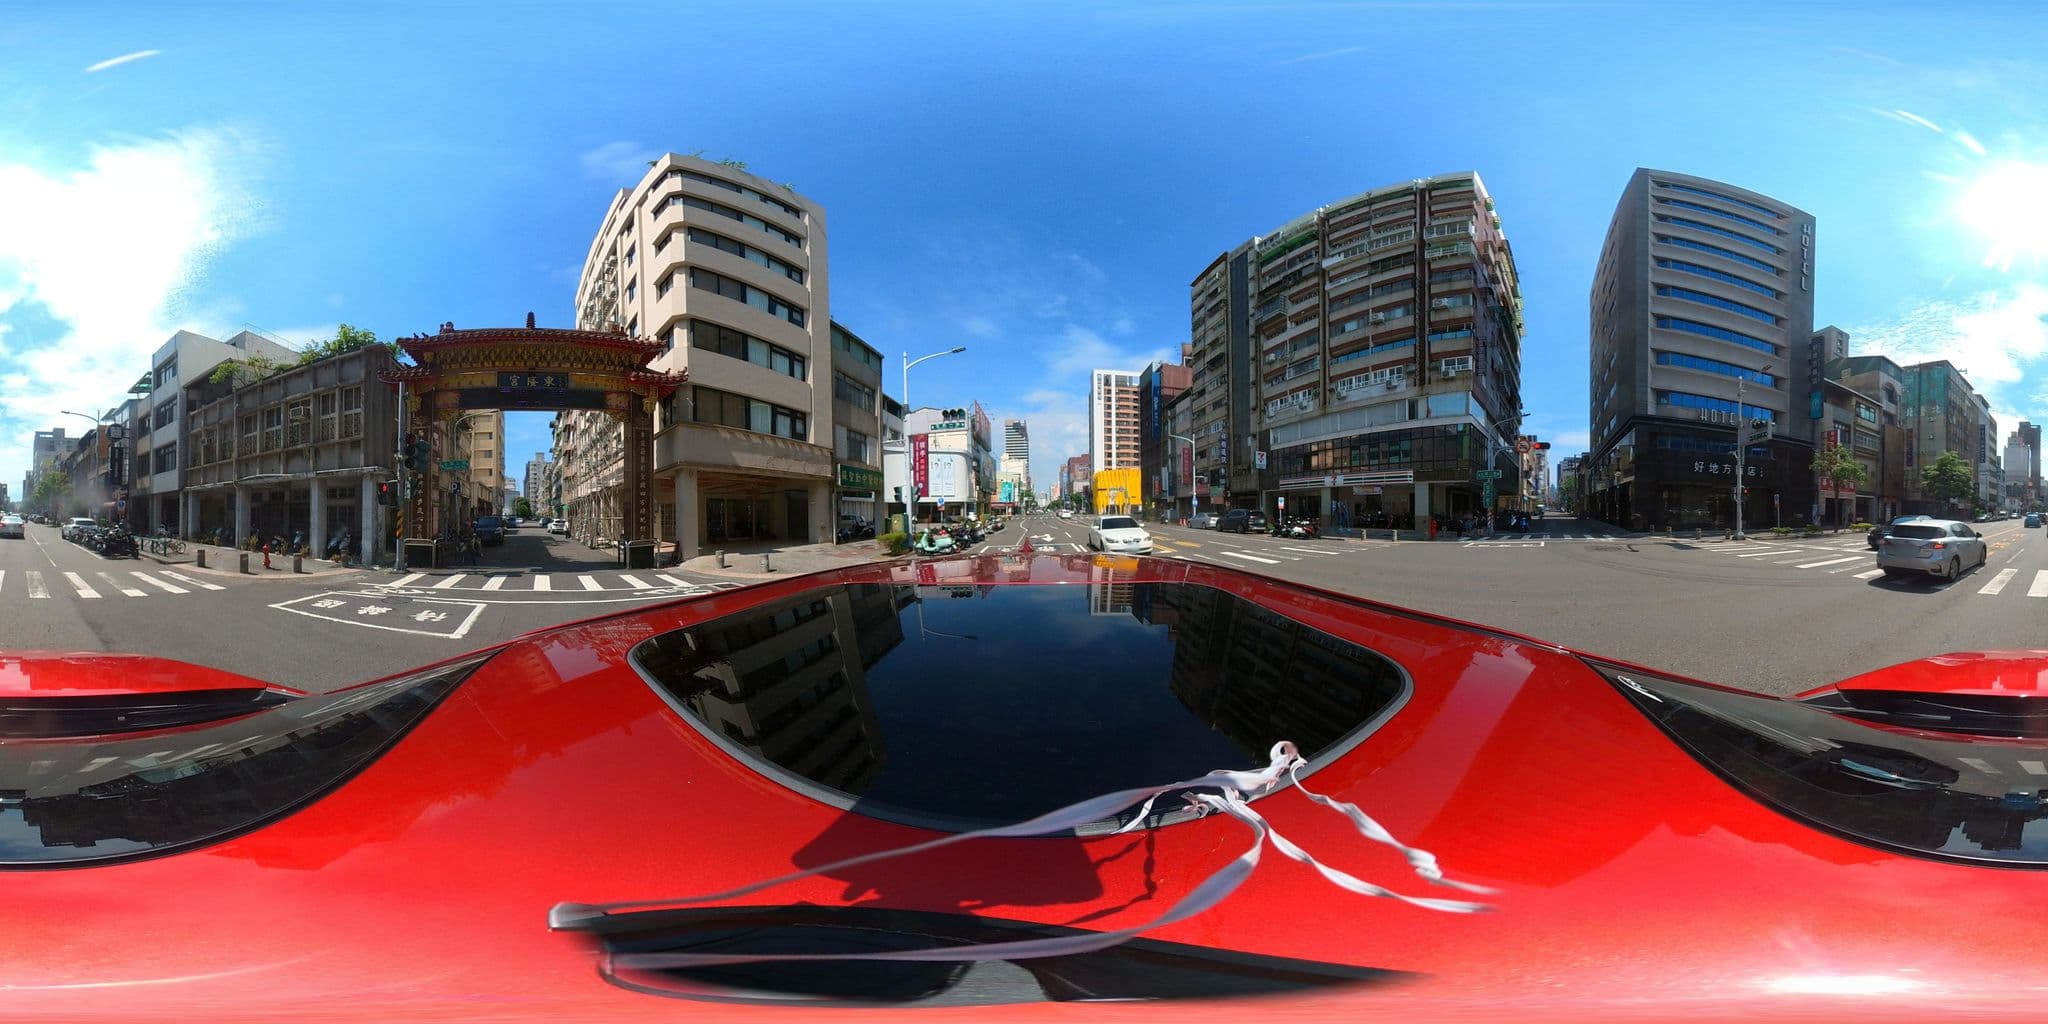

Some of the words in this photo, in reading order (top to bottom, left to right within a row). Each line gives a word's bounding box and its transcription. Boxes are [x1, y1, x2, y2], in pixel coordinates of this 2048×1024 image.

[1802, 224, 1811, 292] HOTEL
[1700, 407, 1744, 426] HOTE
[1694, 460, 1757, 477] 好地方店
